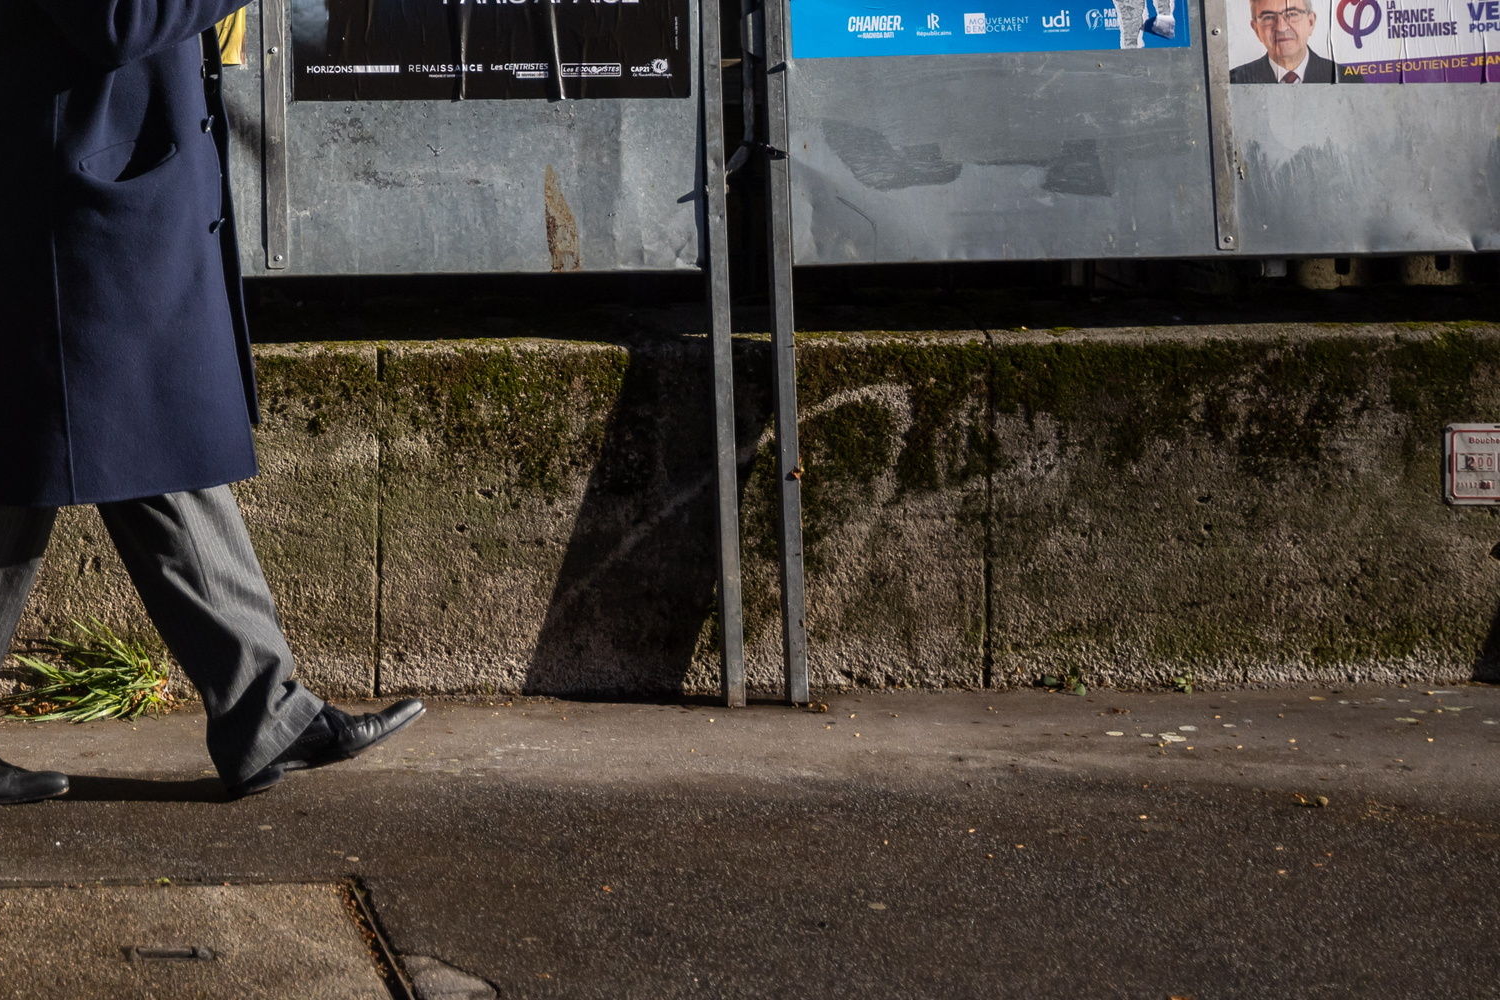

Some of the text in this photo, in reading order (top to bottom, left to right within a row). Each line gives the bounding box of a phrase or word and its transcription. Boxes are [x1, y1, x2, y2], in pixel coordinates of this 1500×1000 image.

[1386, 0, 1396, 10] LA
[1387, 8, 1435, 28] FRANCE
[306, 65, 353, 74] HORIZONS
[409, 64, 484, 72] RENAISSANCE
[1344, 57, 1468, 76] AVEC LE SOUTIEN DE
